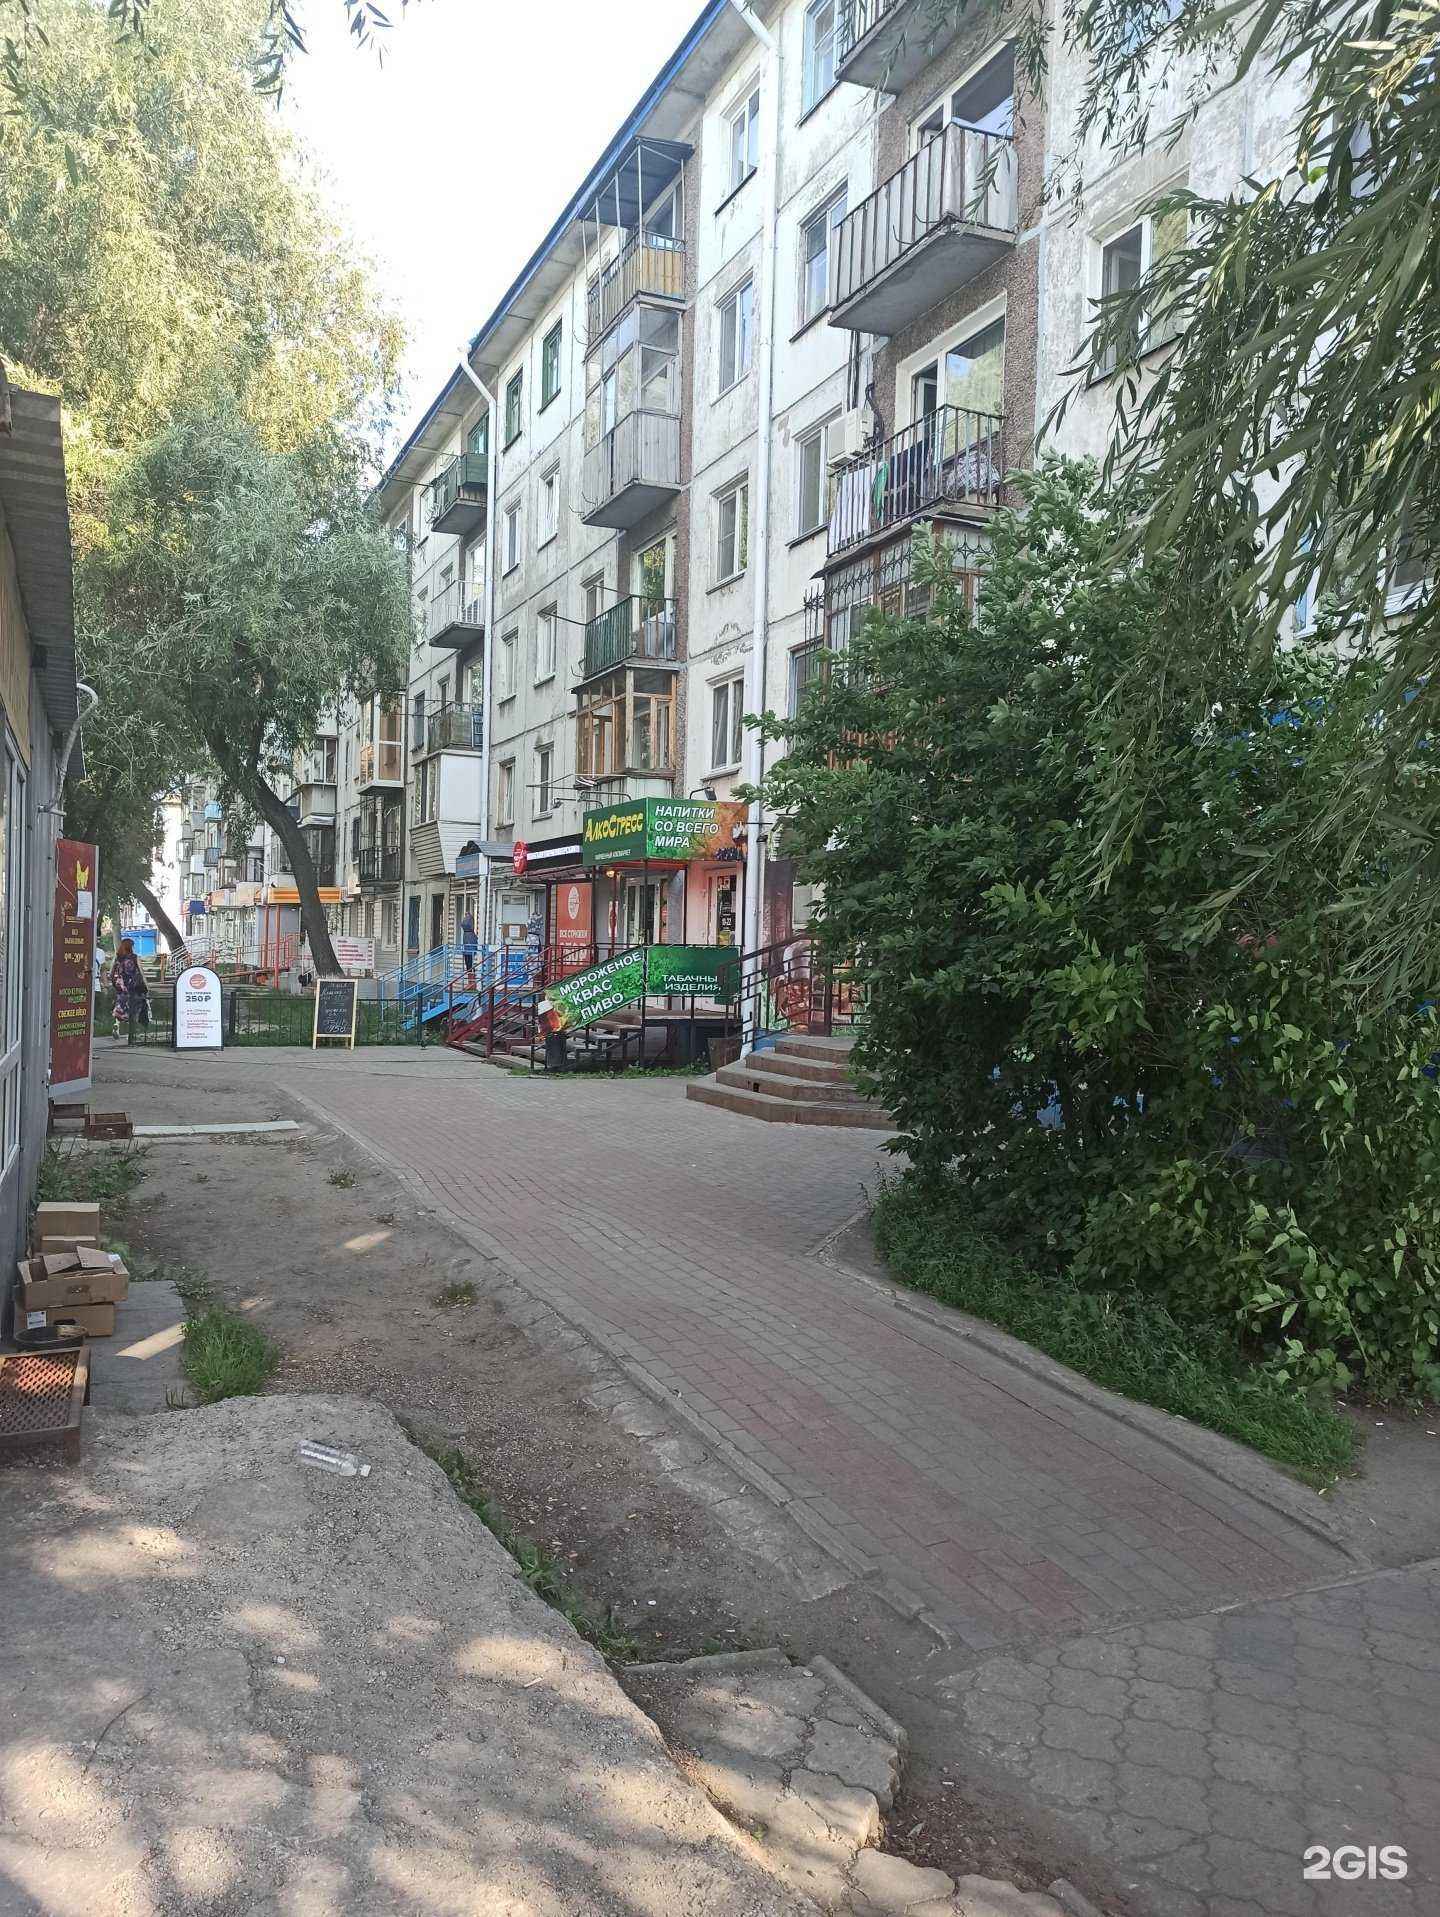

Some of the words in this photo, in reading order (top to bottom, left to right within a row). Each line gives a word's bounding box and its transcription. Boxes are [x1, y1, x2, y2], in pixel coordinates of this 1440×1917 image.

[655, 805, 715, 819] НАПИТКИ
[654, 820, 673, 832] СО
[676, 821, 719, 834] ВСЕГО
[654, 835, 690, 848] МИРА
[559, 951, 642, 996] МОРОЖЕНОЕ
[661, 974, 719, 983] ТАБАЧНЫ
[572, 979, 613, 1006] КВАС
[580, 992, 624, 1020] ПИВО
